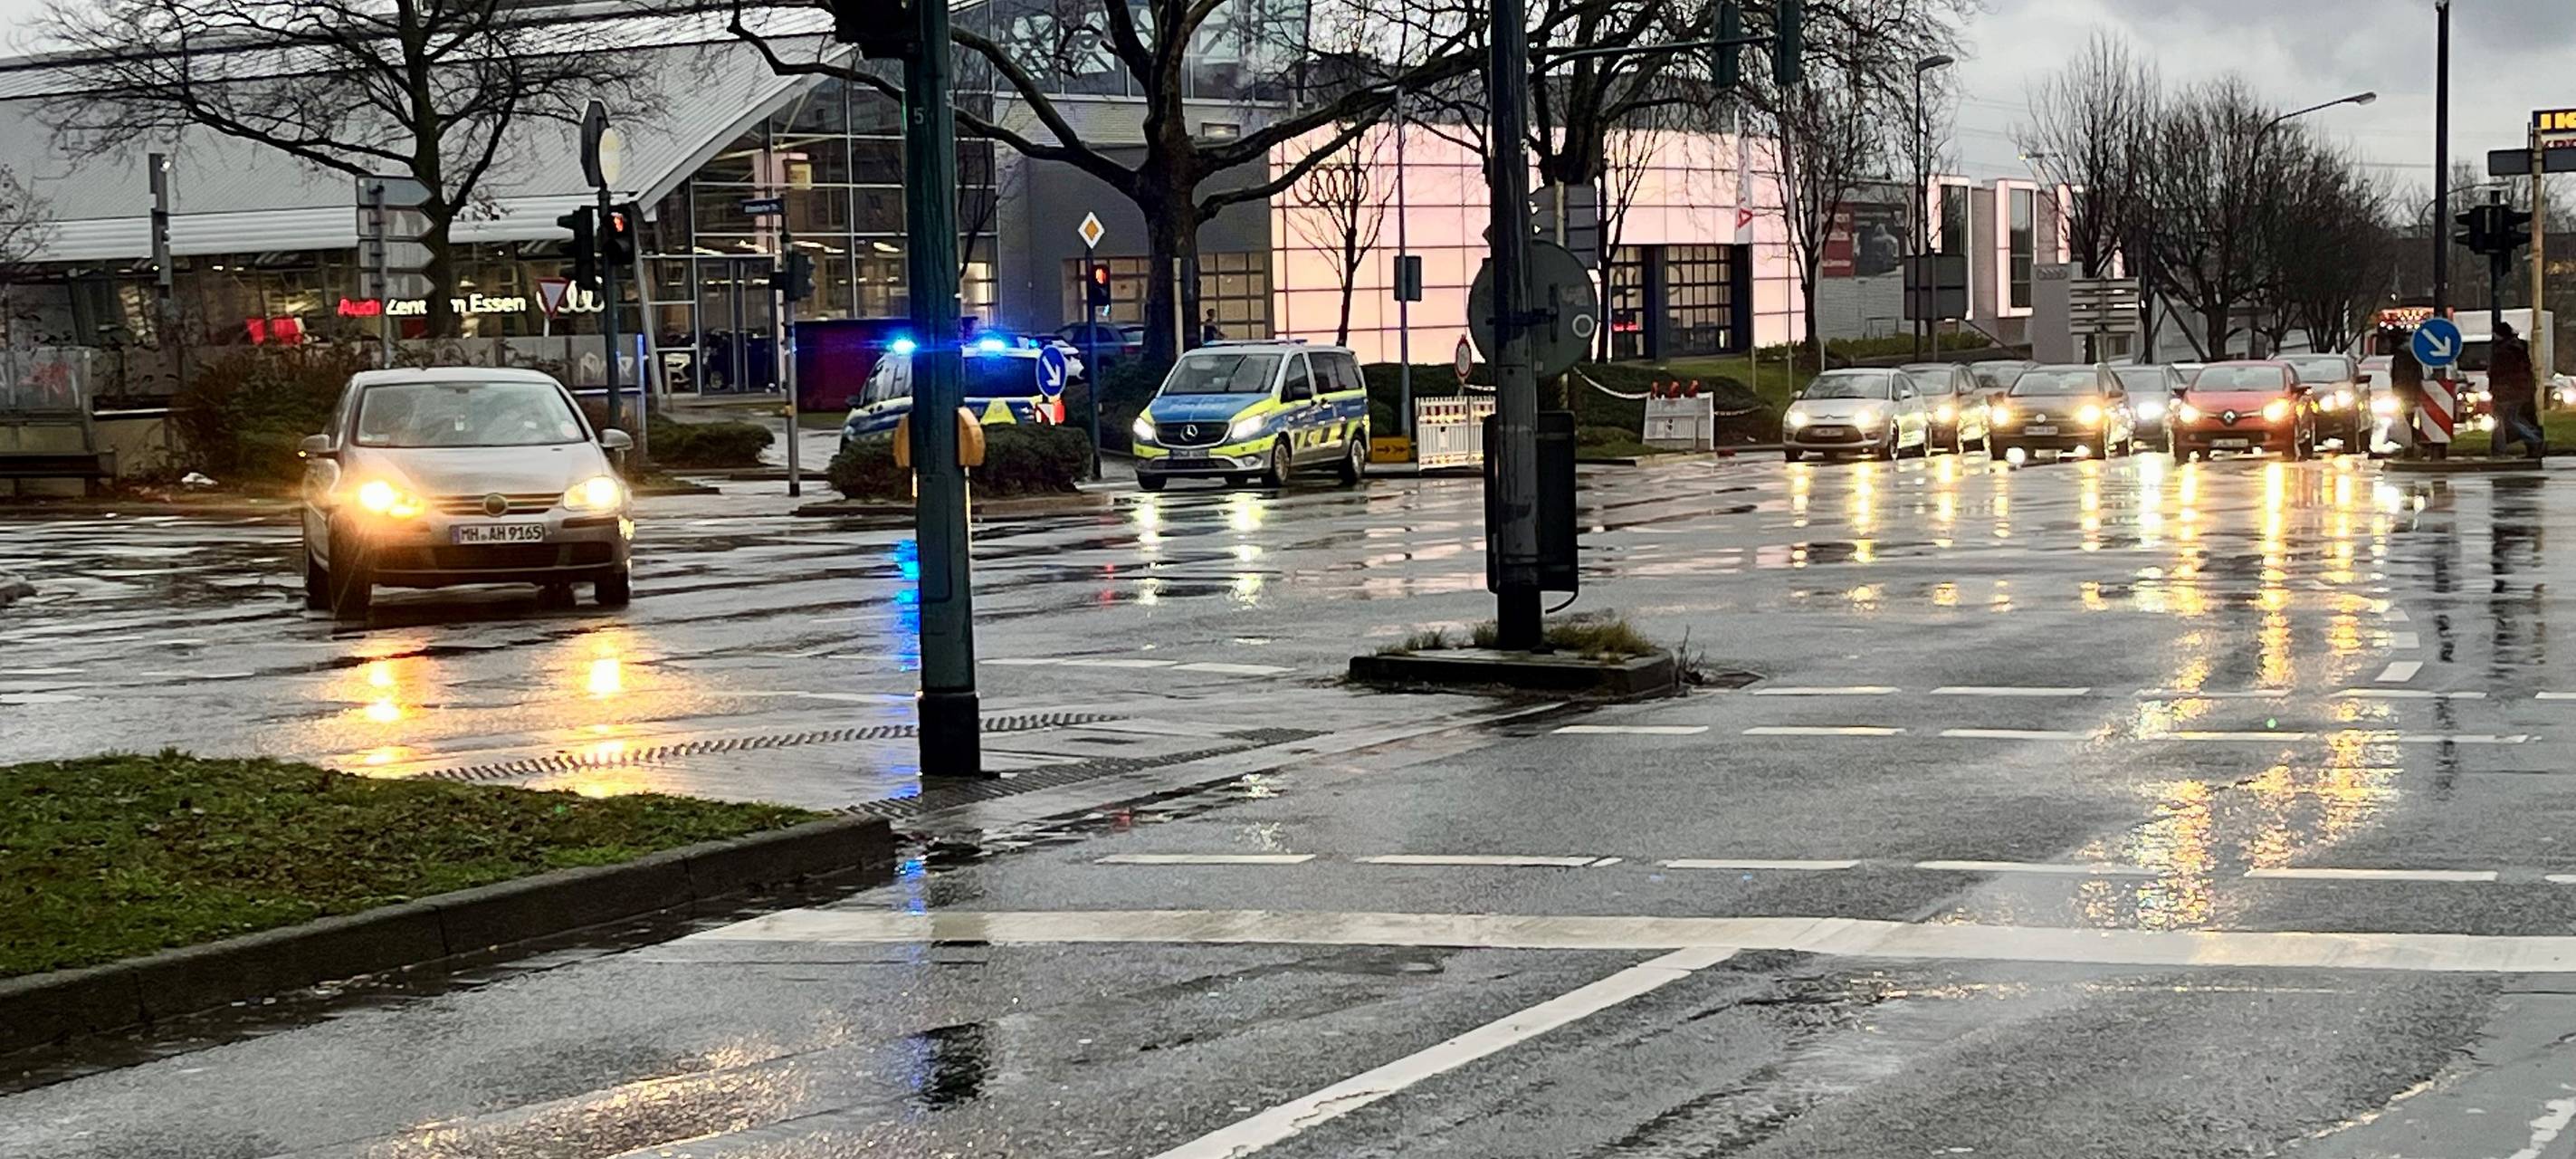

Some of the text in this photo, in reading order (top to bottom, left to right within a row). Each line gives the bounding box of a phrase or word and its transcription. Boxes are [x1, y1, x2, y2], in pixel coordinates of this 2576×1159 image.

[913, 107, 924, 124] 5
[1520, 138, 1530, 155] 3
[338, 298, 381, 316] Audi
[469, 292, 526, 313] Essen
[461, 525, 541, 541] MH AH 9165
